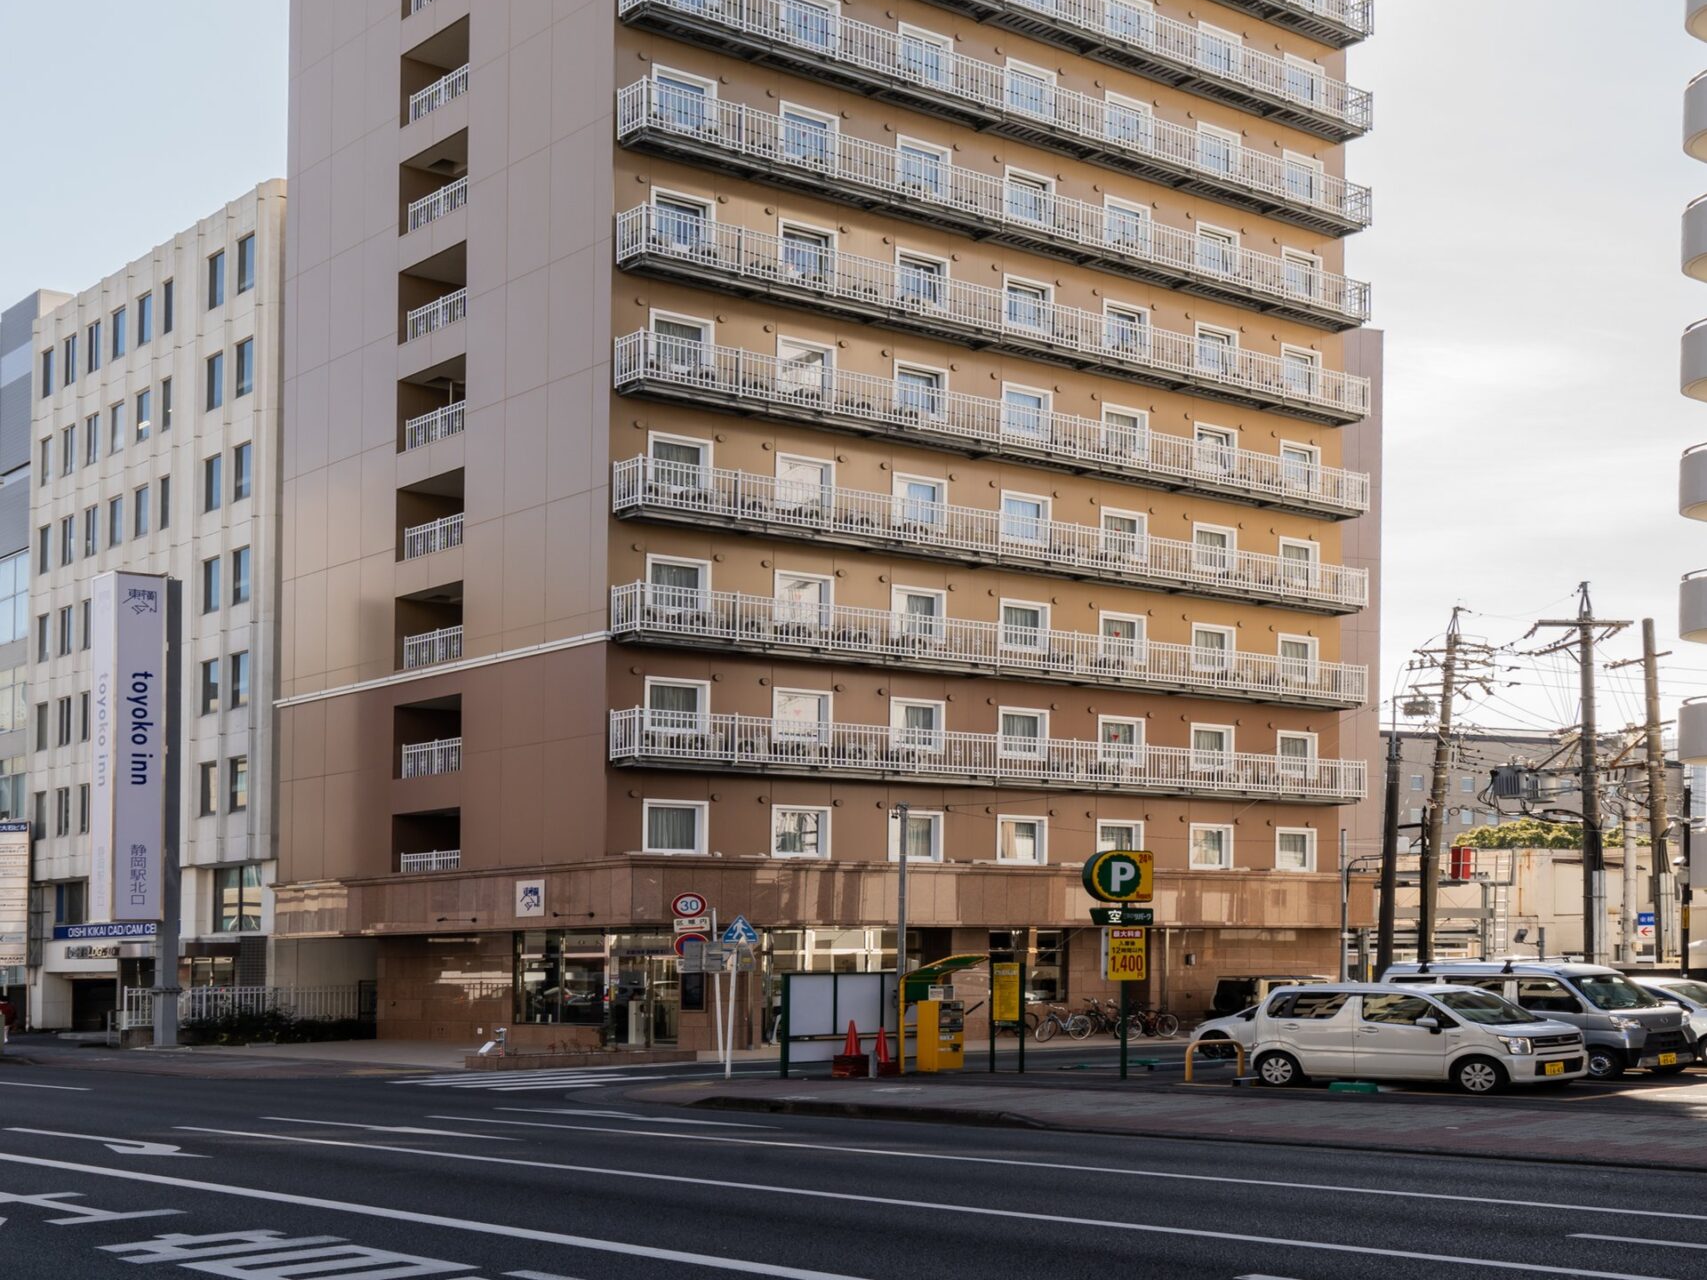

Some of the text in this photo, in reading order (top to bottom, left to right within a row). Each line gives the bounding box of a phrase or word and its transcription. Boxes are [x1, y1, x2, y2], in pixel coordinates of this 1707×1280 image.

[97, 672, 109, 788] toyoko inn
[126, 671, 154, 786] toyoko inn
[130, 844, 147, 906] 静岡駅北口
[1110, 861, 1136, 892] P
[680, 900, 699, 912] 30
[1108, 910, 1122, 923] 空
[67, 923, 157, 938] OISHI KIKAI CAD/CAM CE
[1111, 954, 1143, 974] 1,400
